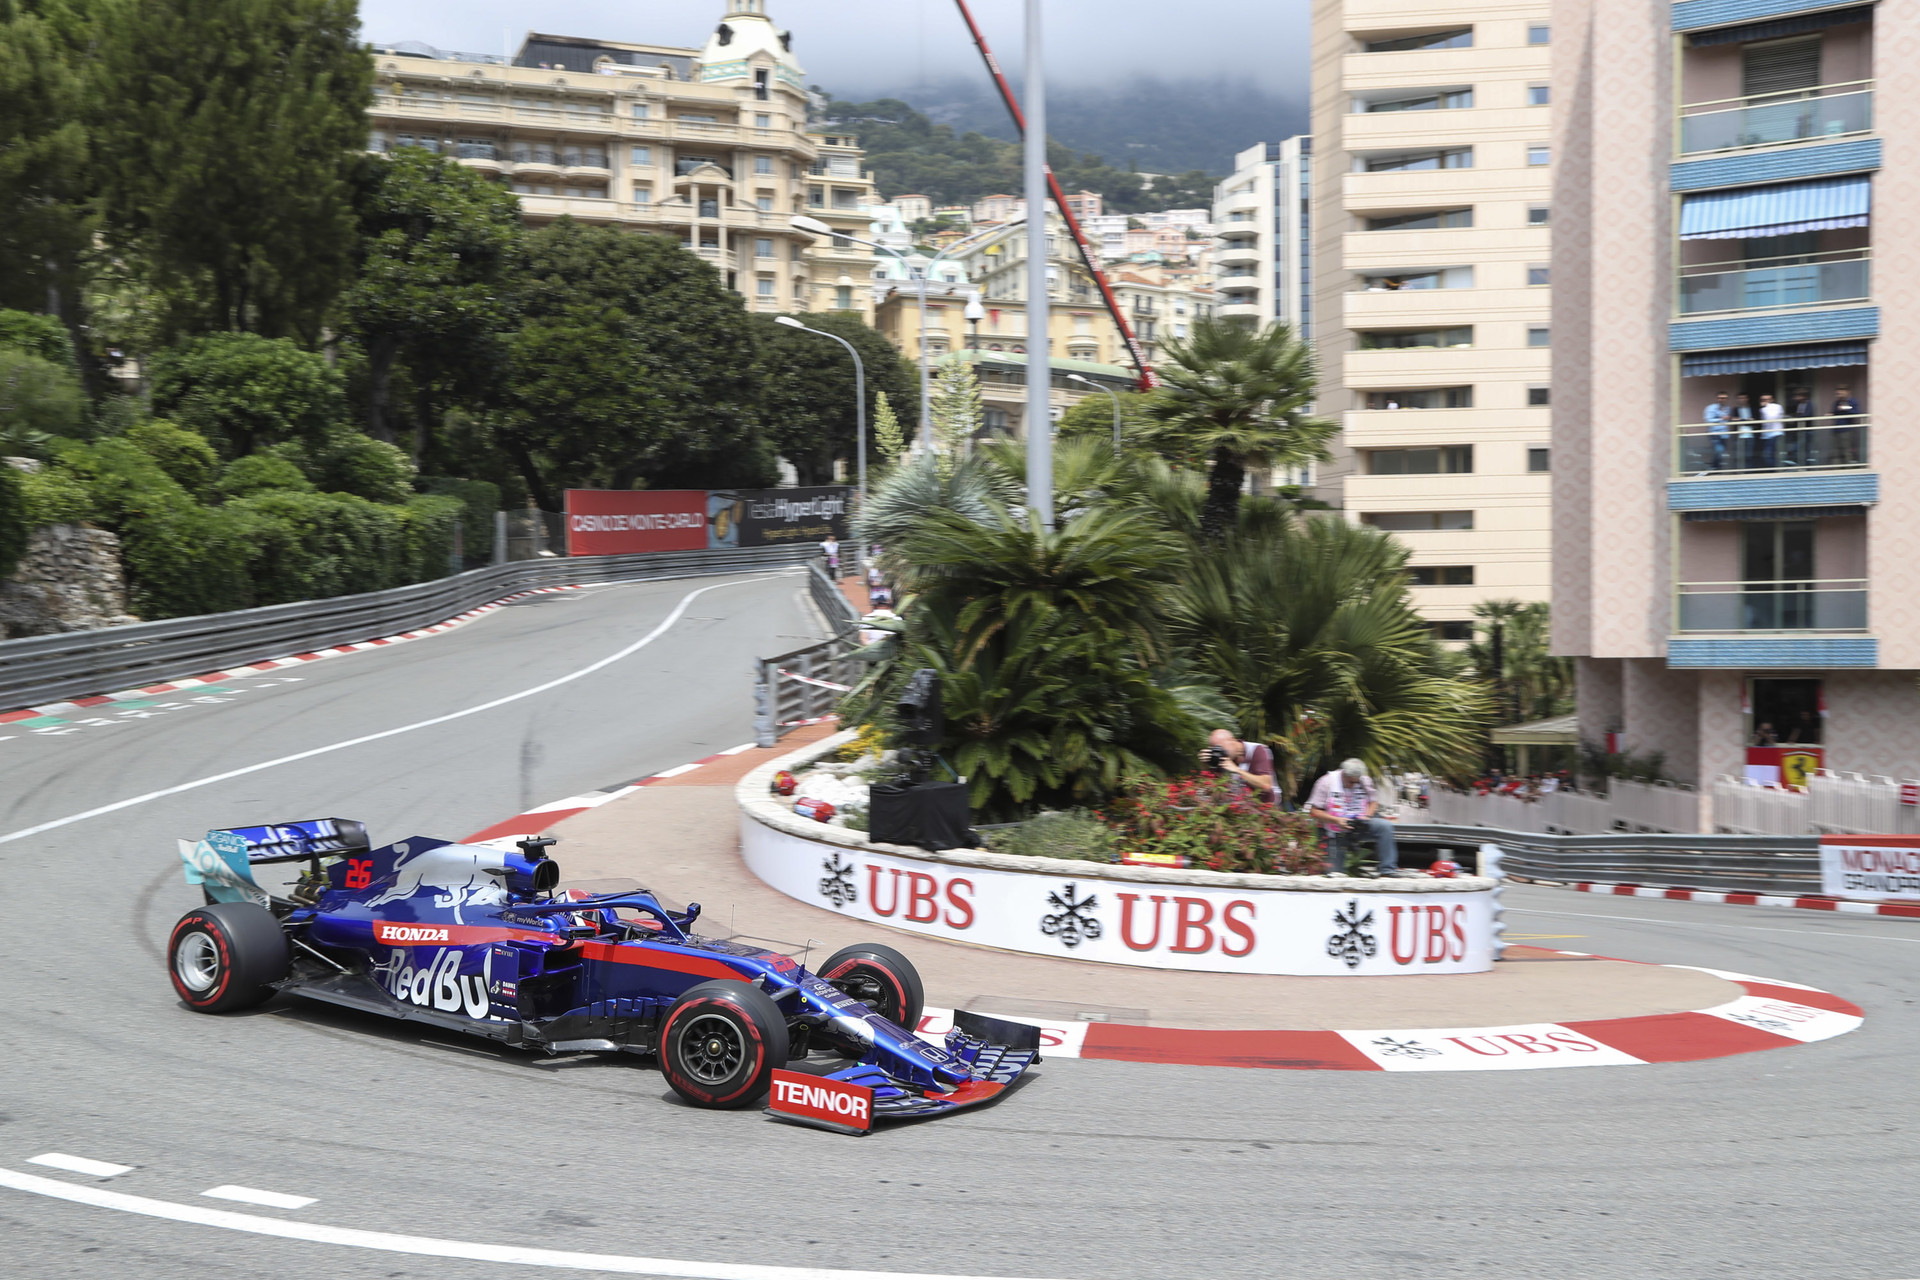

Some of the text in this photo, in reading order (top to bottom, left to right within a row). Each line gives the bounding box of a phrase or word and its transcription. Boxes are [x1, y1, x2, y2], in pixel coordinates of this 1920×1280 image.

[344, 858, 373, 889] 26
[866, 864, 976, 930] UBS
[381, 925, 449, 941] HONDA
[516, 916, 544, 927] myWorld
[1116, 893, 1257, 957] UBS
[1387, 904, 1467, 965] UBS
[1440, 1032, 1598, 1056] UBS
[773, 1079, 868, 1120] TENNOR
